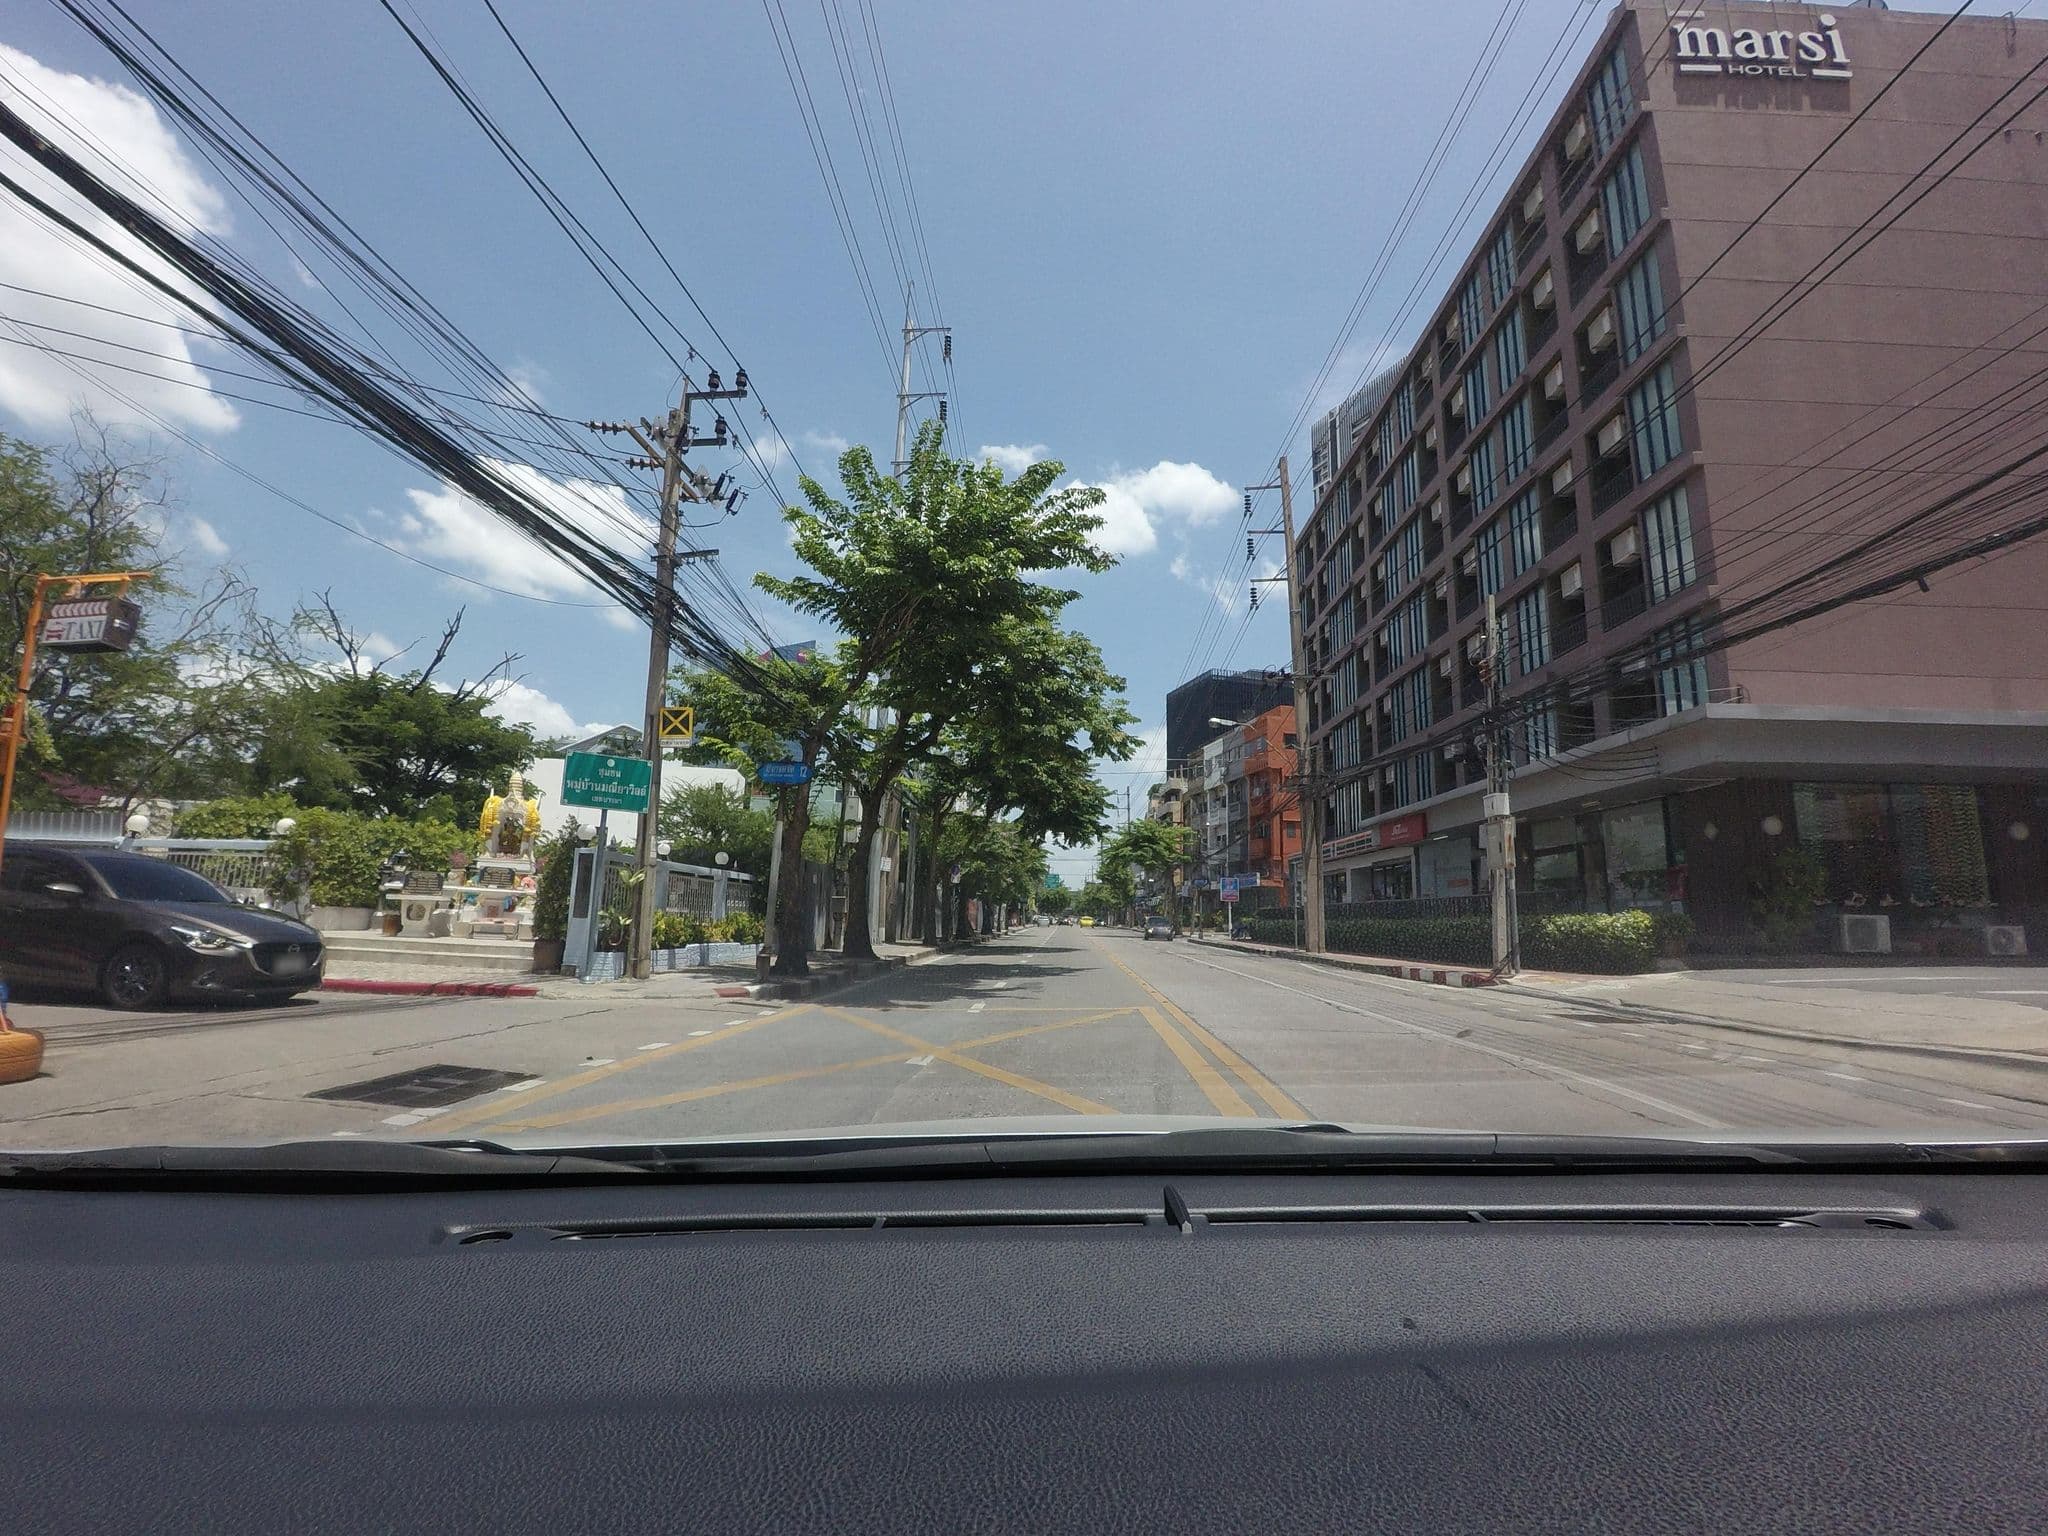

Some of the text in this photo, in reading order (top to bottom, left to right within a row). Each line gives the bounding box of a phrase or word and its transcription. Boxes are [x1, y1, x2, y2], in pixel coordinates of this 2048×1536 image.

[1672, 14, 1850, 63] marsi
[1728, 64, 1807, 77] HOTEL
[65, 620, 104, 640] TAXI
[598, 768, 622, 779] ชุมชน
